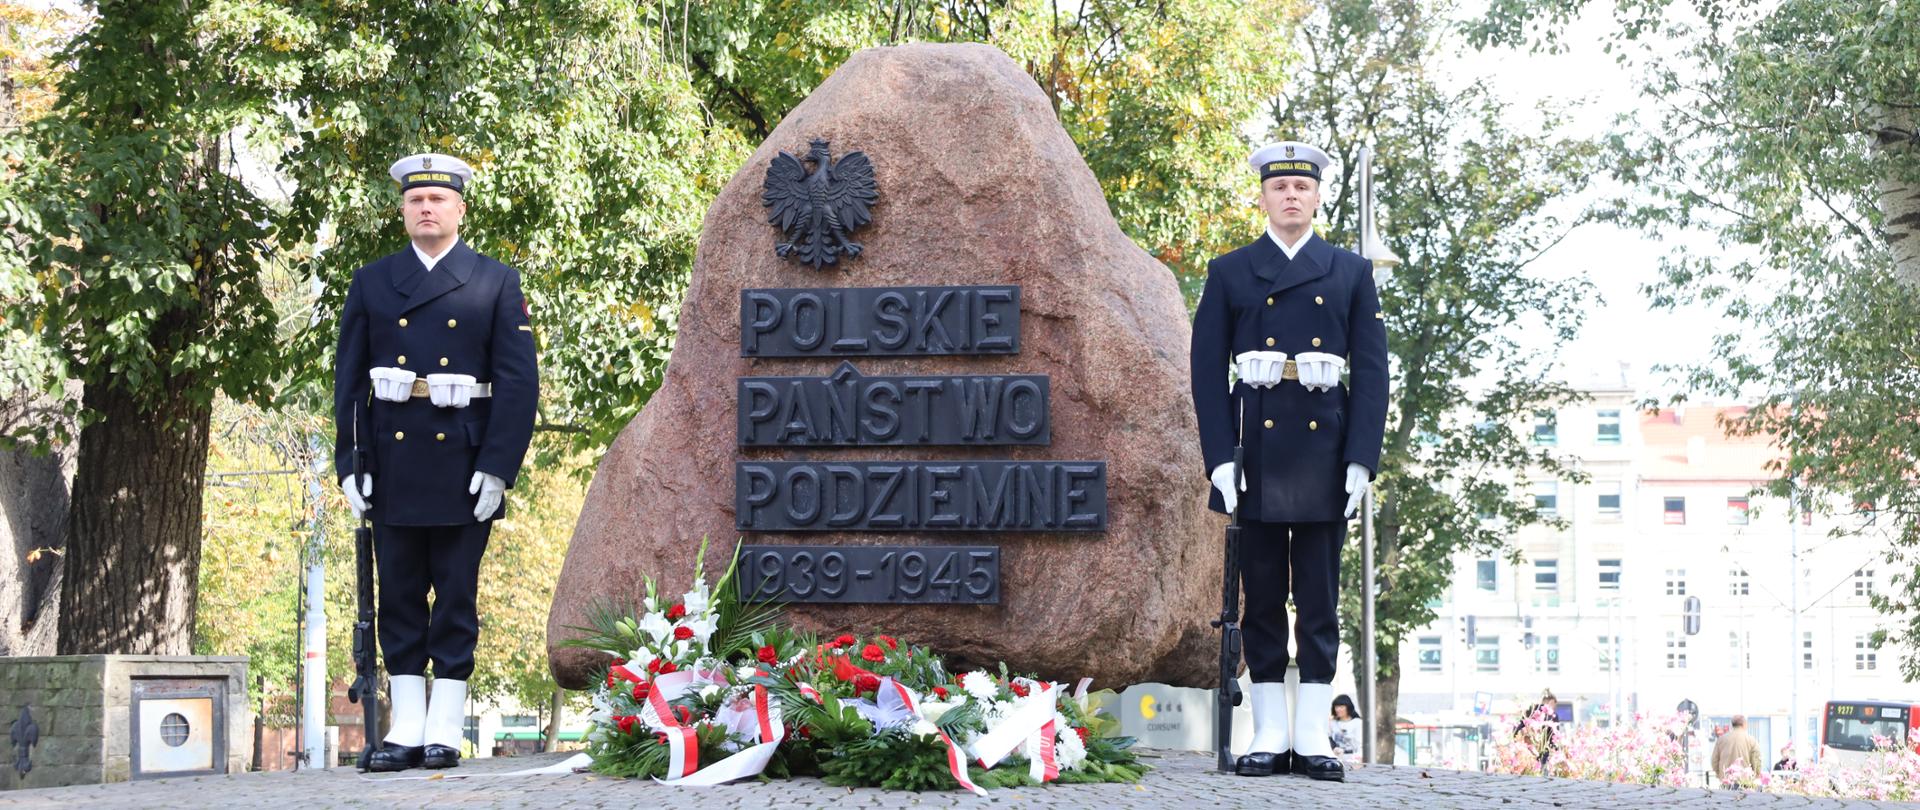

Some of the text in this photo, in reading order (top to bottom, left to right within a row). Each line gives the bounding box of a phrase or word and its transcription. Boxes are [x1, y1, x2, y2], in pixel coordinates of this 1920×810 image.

[748, 290, 1012, 352] POLSKIE
[743, 367, 1044, 442] PAŃSTWO
[740, 464, 1098, 528] PODZIEMNE
[1837, 706, 1854, 716] 9277
